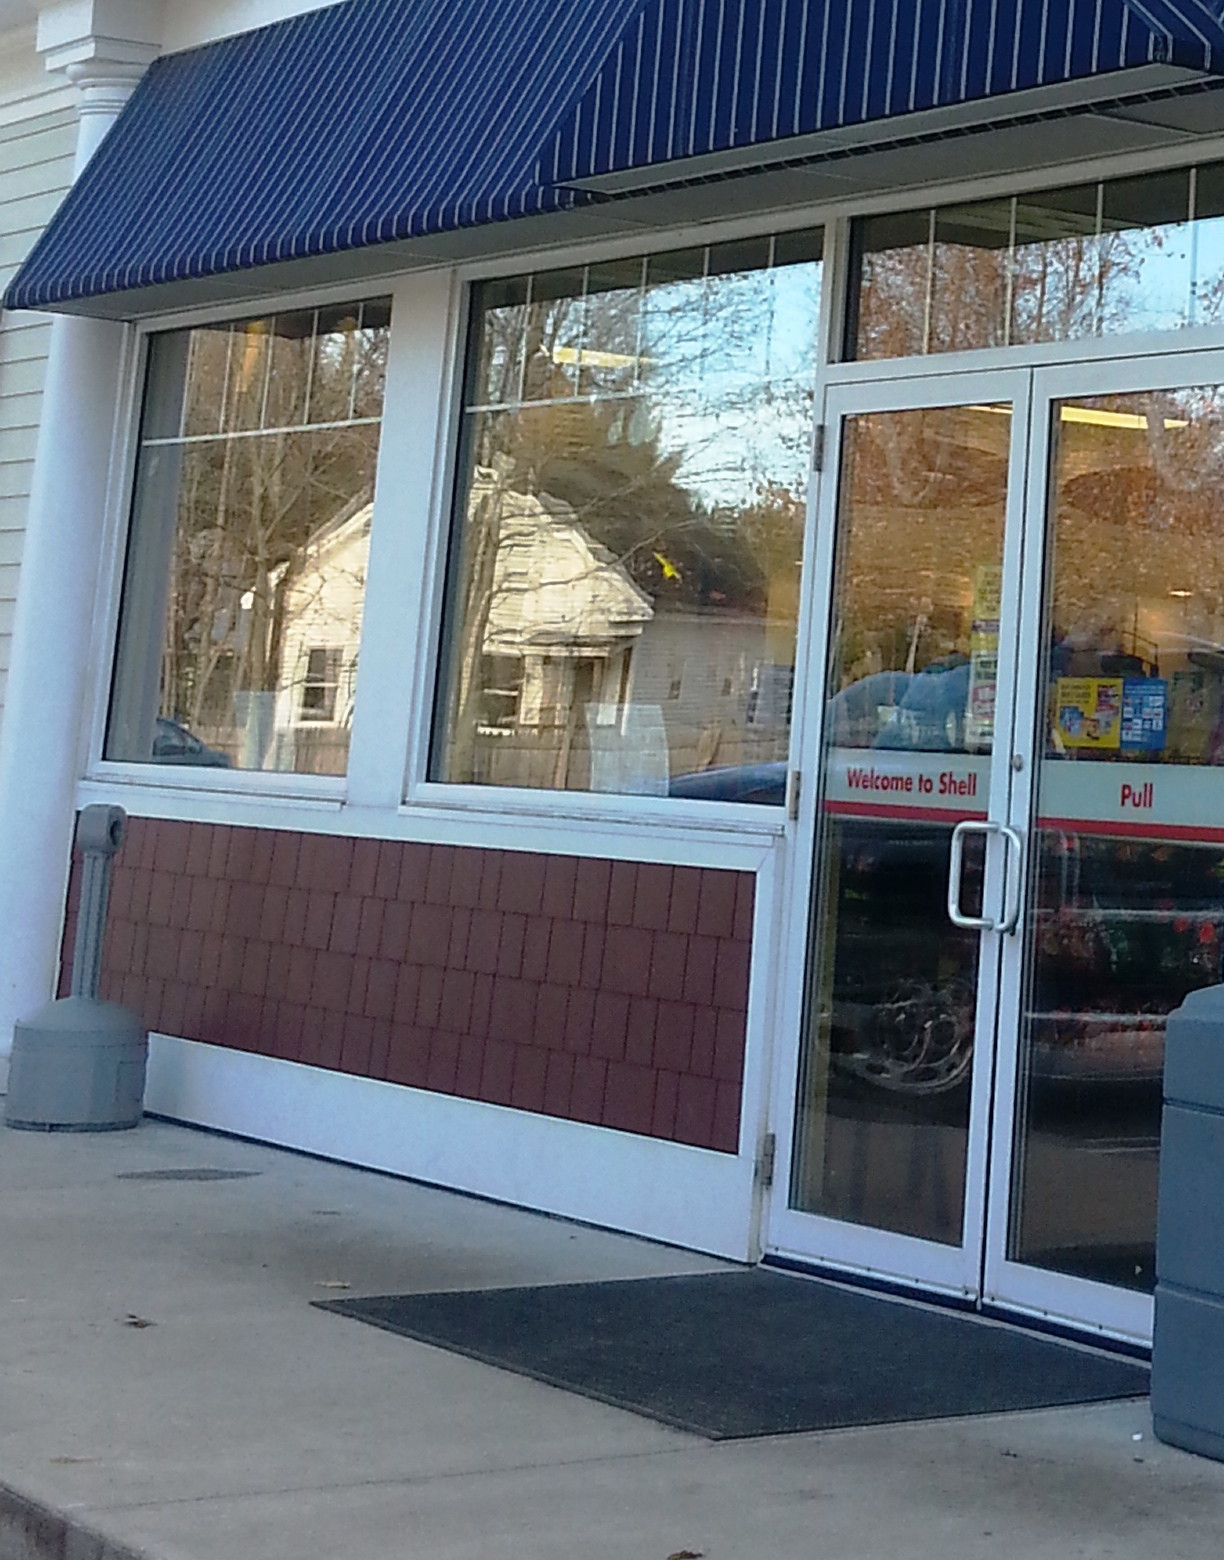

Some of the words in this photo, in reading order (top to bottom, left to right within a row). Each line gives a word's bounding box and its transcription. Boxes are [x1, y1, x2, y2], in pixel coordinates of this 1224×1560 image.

[847, 767, 913, 792] Welcome
[918, 773, 934, 793] to
[938, 771, 977, 796] Shell
[1121, 782, 1153, 808] Pull
